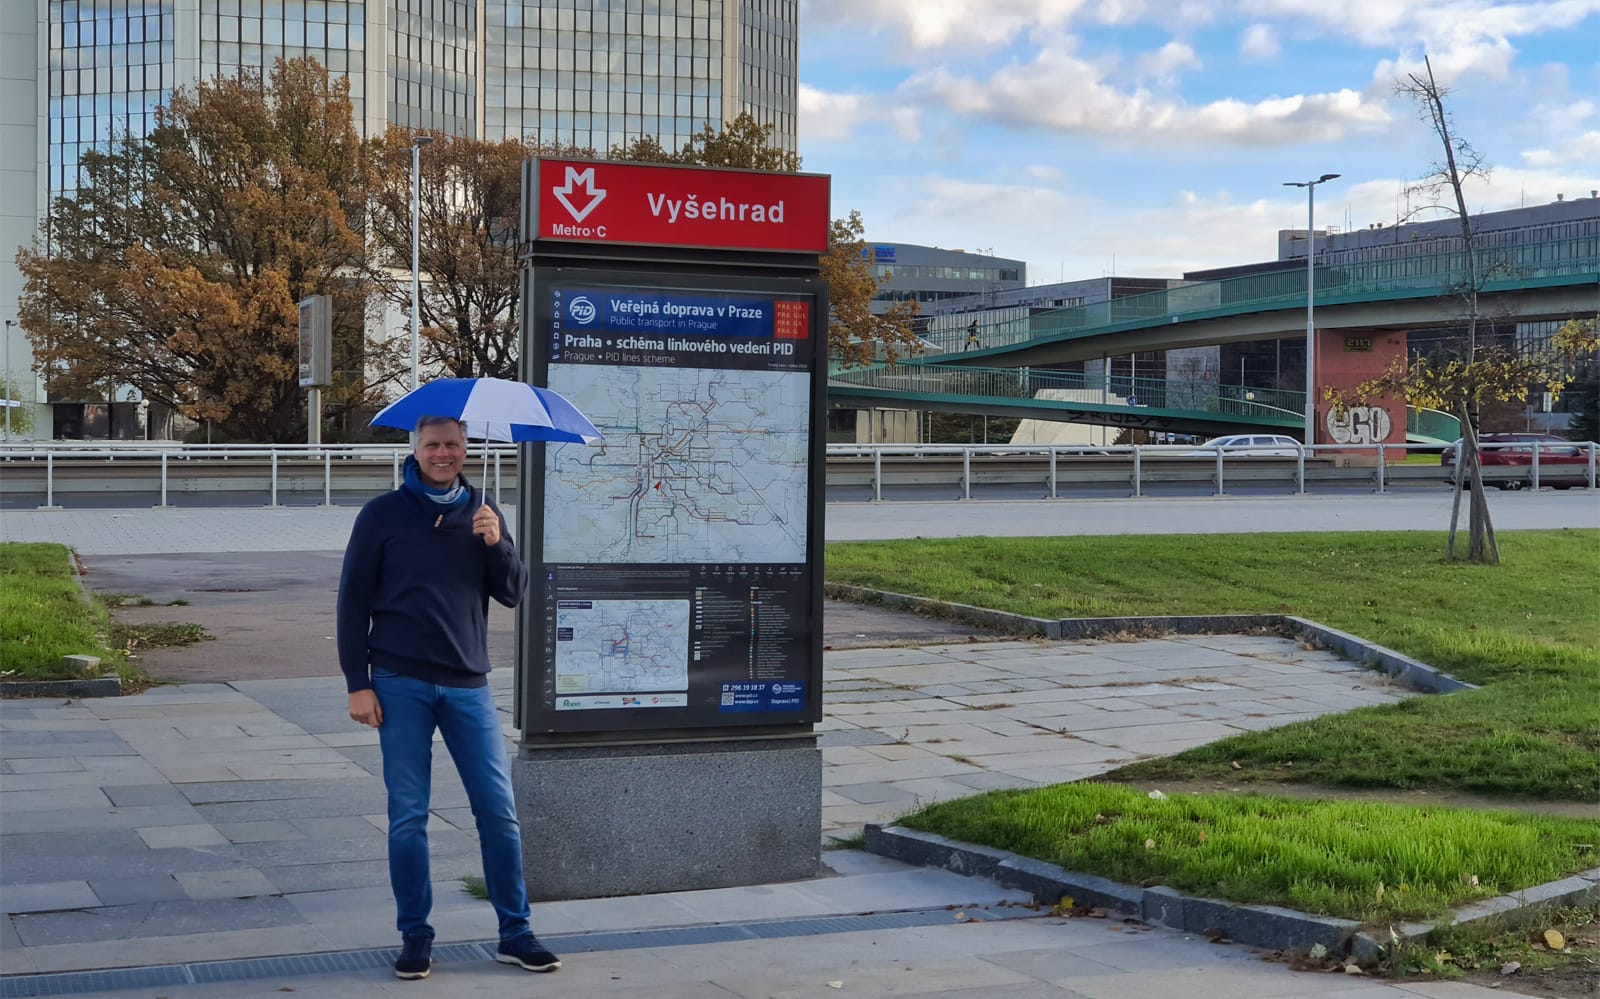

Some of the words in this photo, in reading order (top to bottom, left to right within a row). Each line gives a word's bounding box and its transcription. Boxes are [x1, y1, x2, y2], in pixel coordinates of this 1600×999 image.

[647, 193, 785, 223] Vyšehrad
[611, 299, 660, 316] Veřejná
[663, 301, 714, 318] doprava
[717, 307, 726, 317] v
[728, 305, 763, 319] Praze
[610, 316, 635, 326] Public
[638, 317, 676, 328] transport
[678, 319, 686, 327] in
[688, 319, 718, 331] Prague
[565, 334, 602, 348] Praha
[616, 336, 664, 350] schéma
[667, 338, 727, 353] linkového
[730, 341, 771, 355] vedení
[773, 343, 794, 355] PID
[564, 350, 595, 362] Prague
[622, 352, 640, 362] lines
[643, 354, 676, 363] scheme
